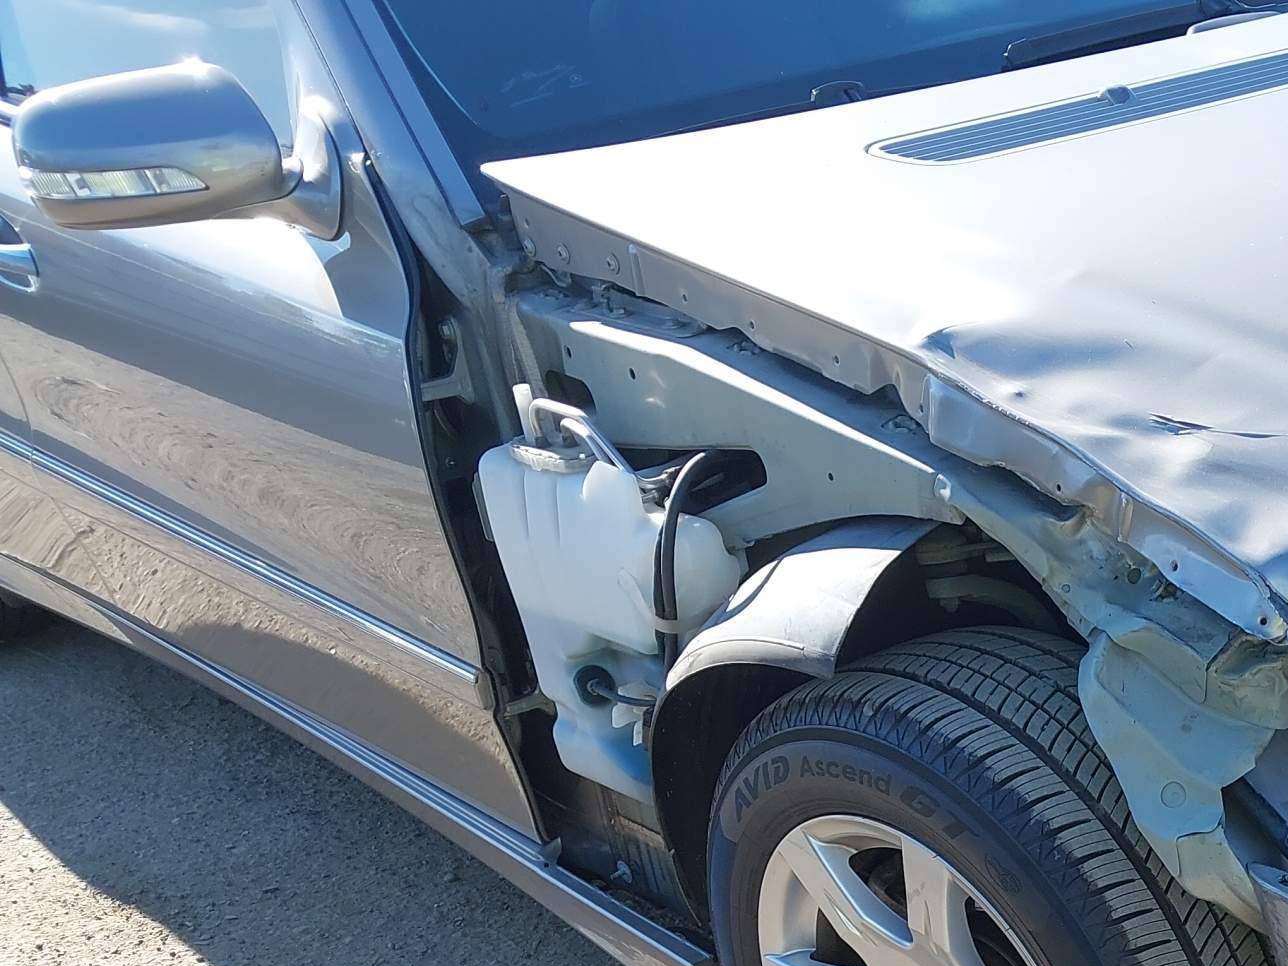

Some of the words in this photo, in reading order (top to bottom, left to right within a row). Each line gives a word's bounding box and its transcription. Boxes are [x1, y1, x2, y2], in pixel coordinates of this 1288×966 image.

[733, 755, 791, 824] AVID
[799, 754, 893, 796] Ascend
[899, 784, 981, 841] GT
